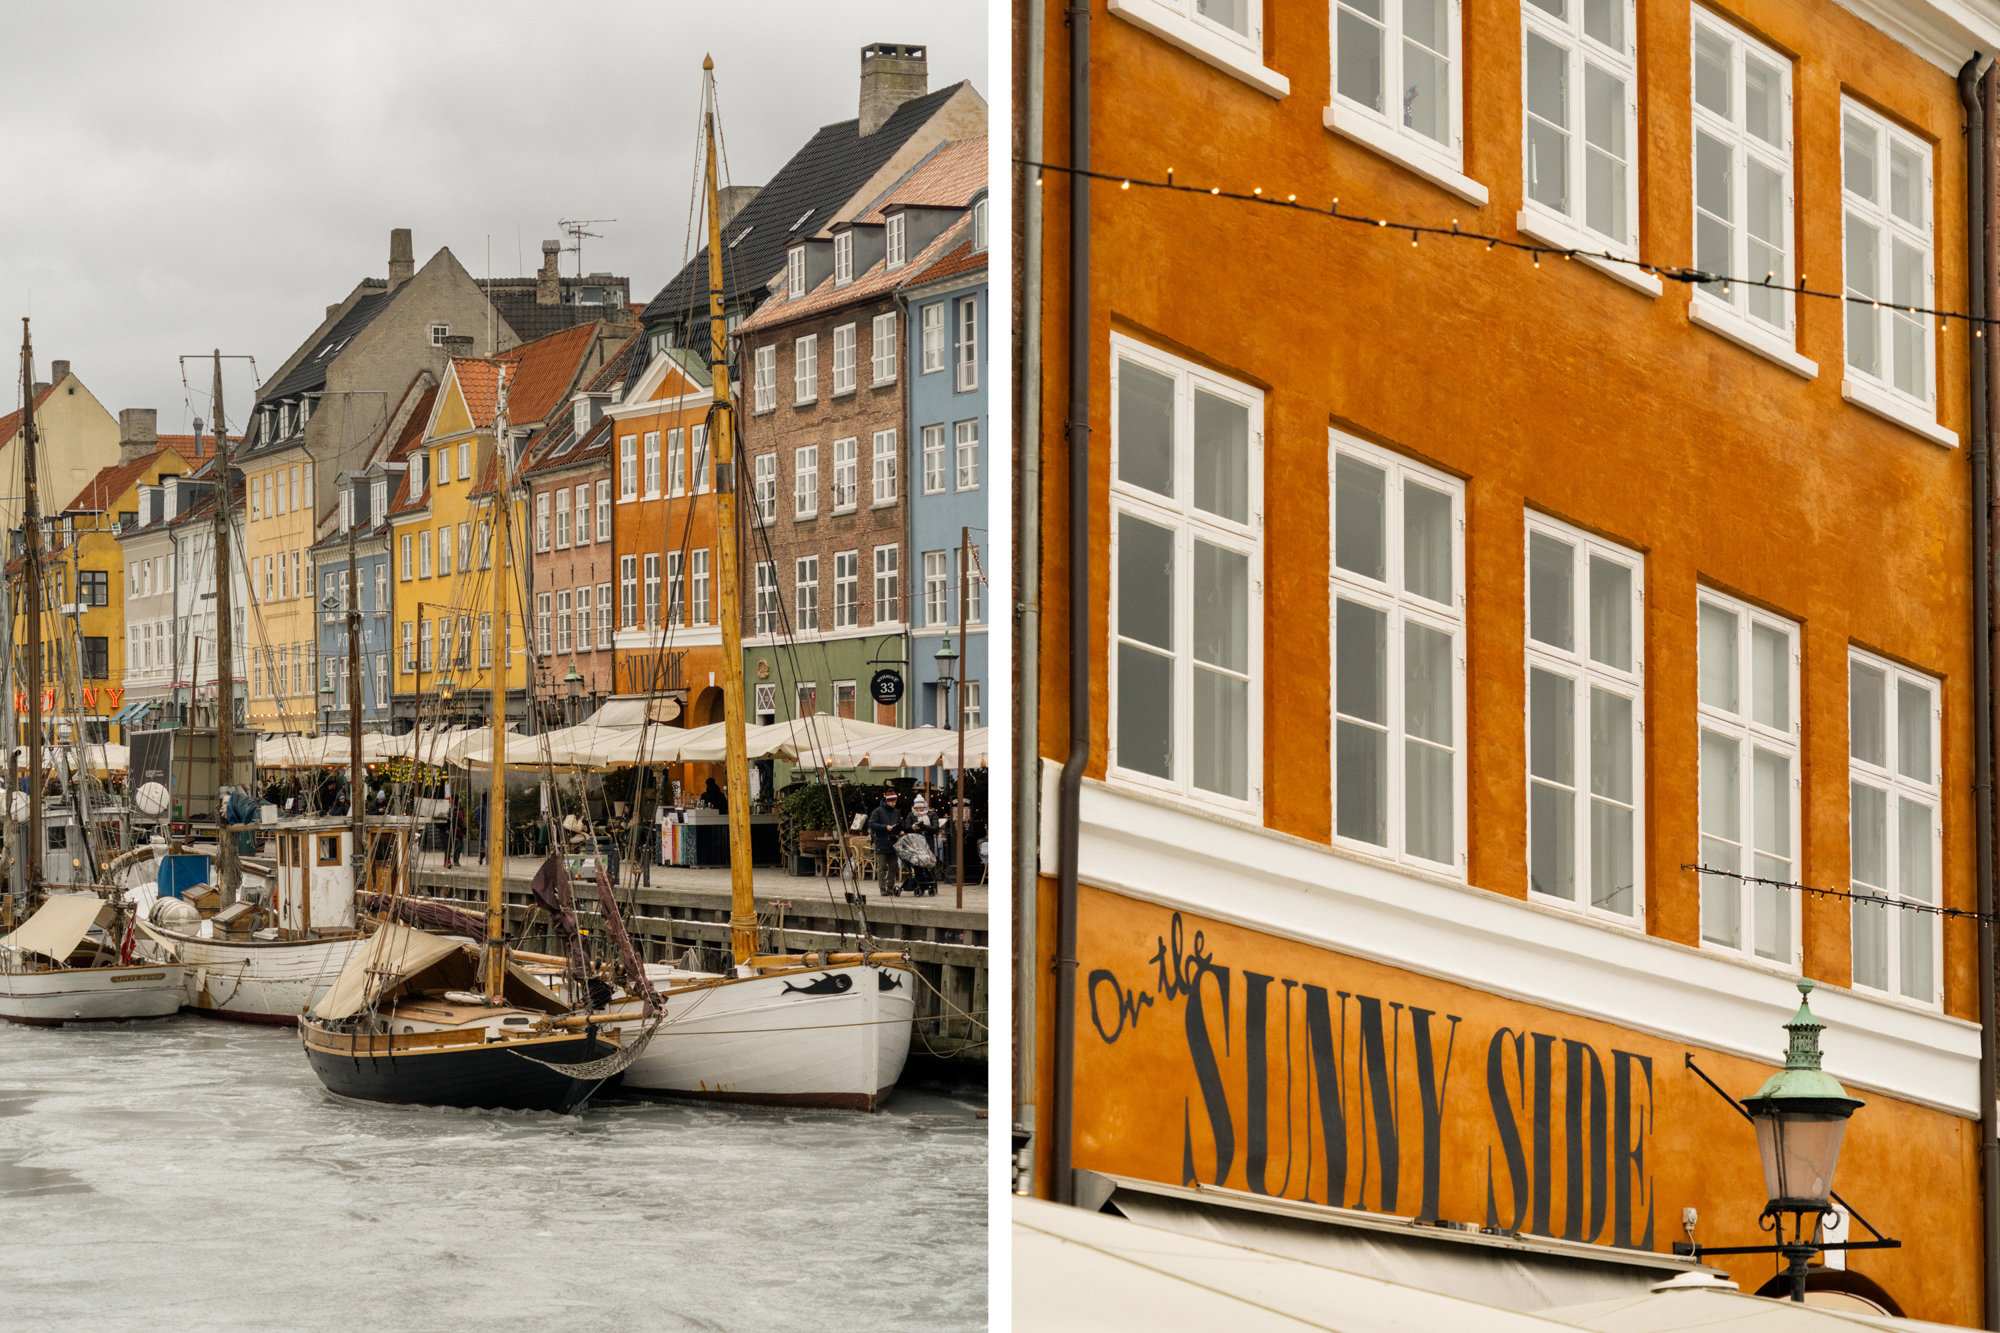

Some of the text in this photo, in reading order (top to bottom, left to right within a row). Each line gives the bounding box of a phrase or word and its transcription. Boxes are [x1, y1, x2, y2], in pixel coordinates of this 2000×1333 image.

[880, 682, 895, 694] 33
[1088, 912, 1213, 1045] On the
[1182, 964, 1655, 1252] SUNNY SIDE
